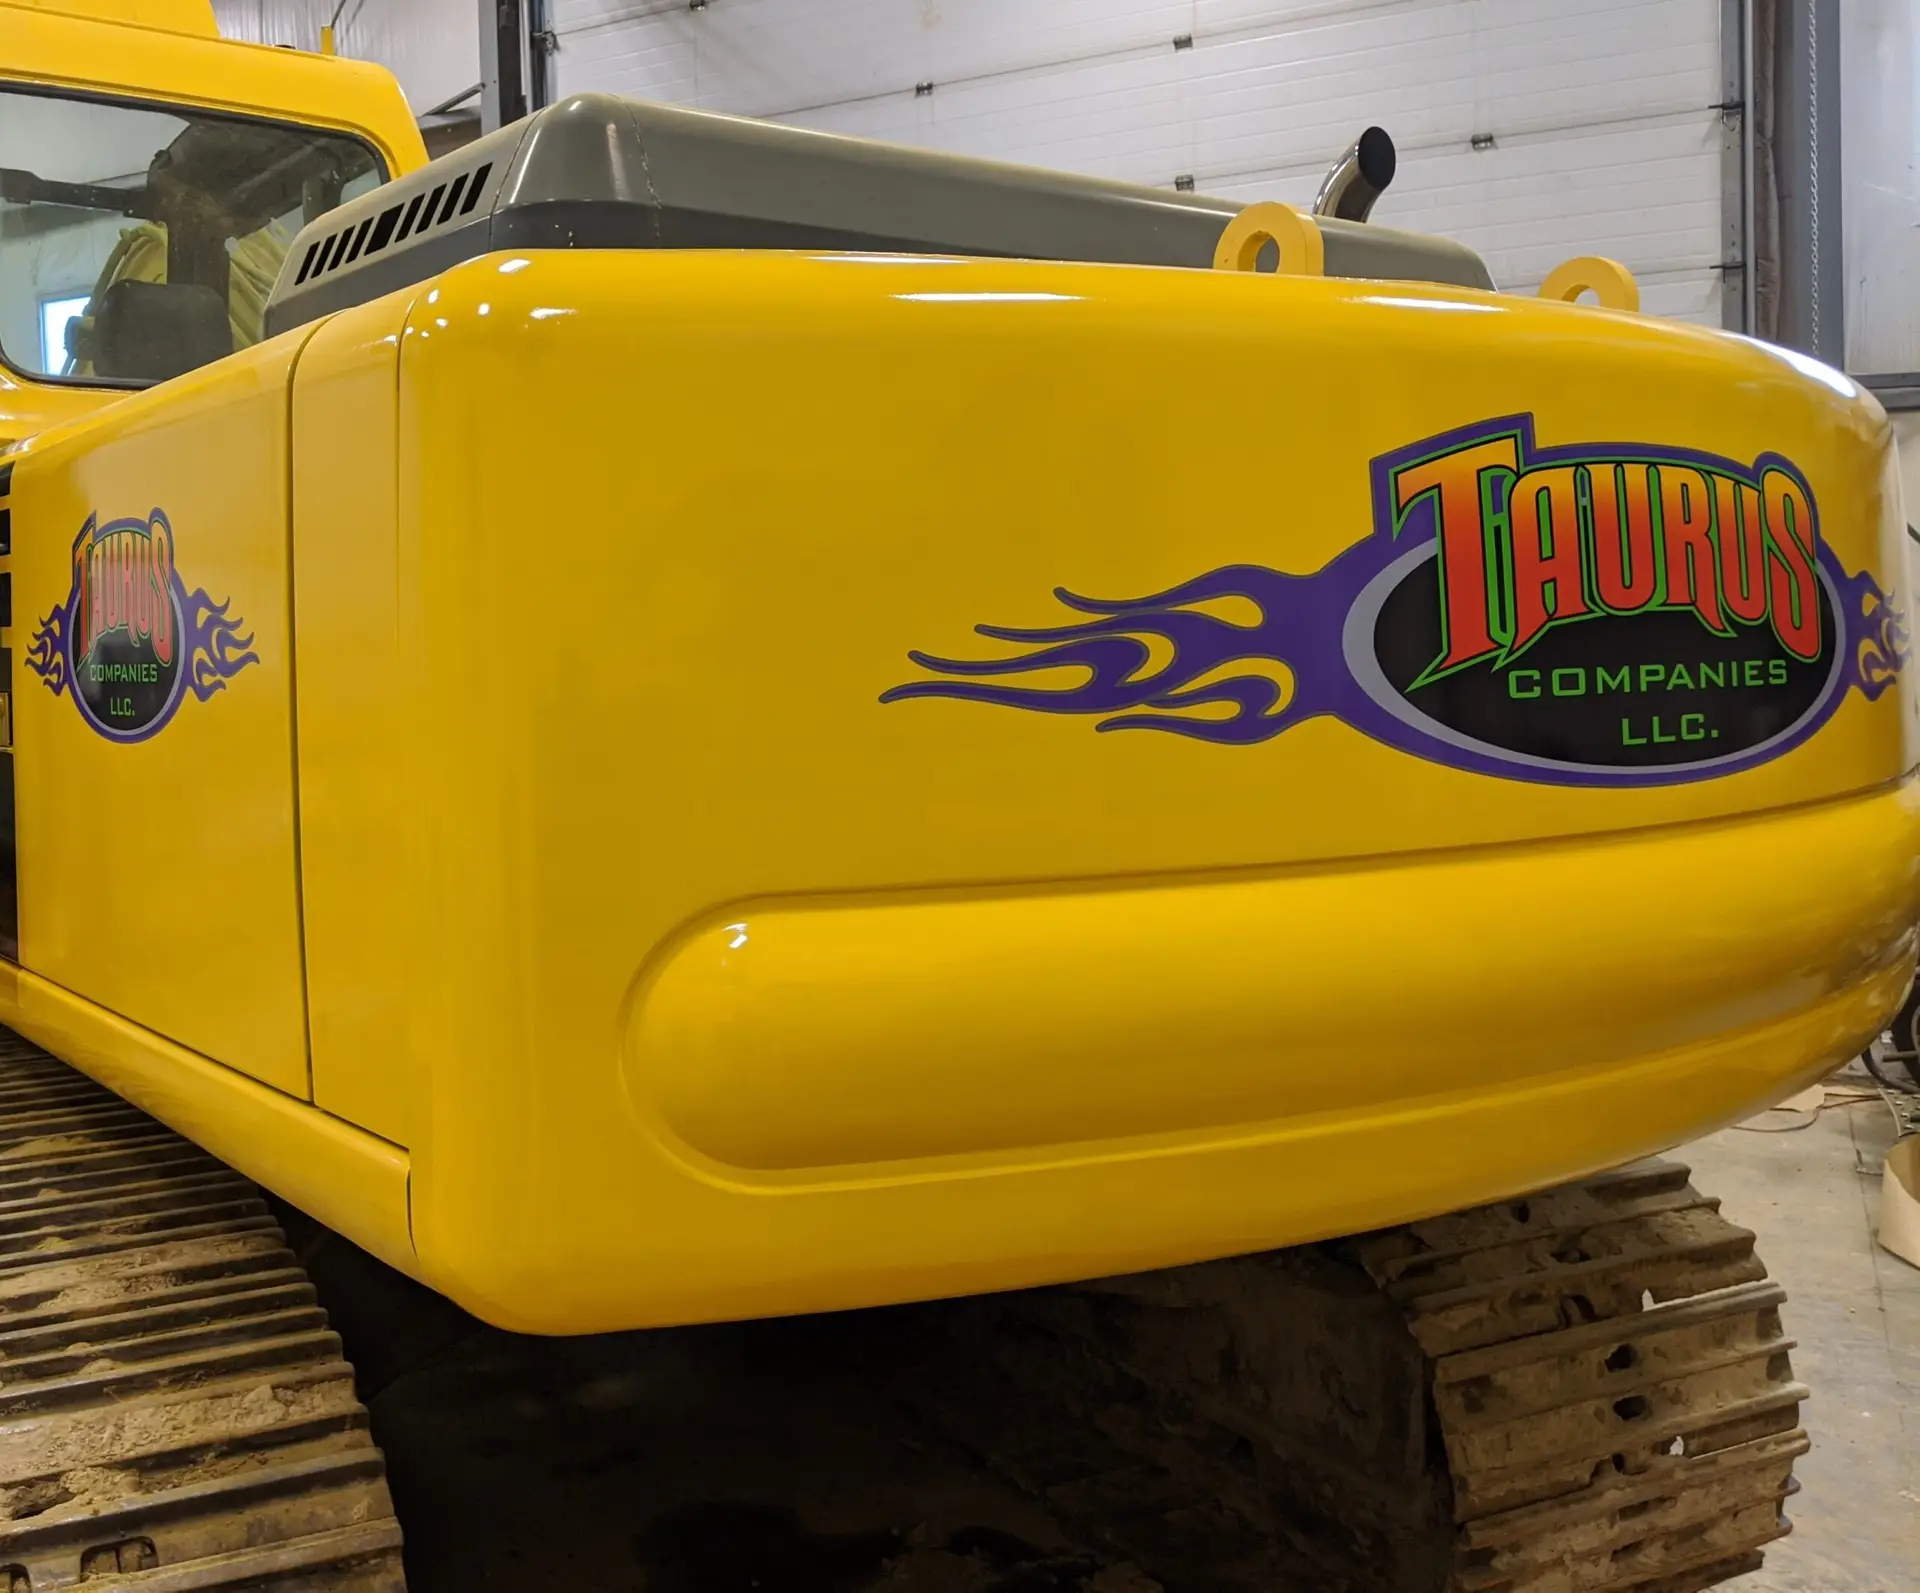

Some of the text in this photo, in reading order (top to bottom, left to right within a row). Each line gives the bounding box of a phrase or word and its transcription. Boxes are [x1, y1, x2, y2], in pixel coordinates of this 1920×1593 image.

[1390, 429, 1821, 691] TAURUS
[74, 518, 172, 672] TAURUS
[90, 664, 157, 682] COMPANIES
[1508, 660, 1787, 699] COMPANIES
[110, 698, 135, 716] LLC.
[1621, 714, 1718, 745] LLC.
